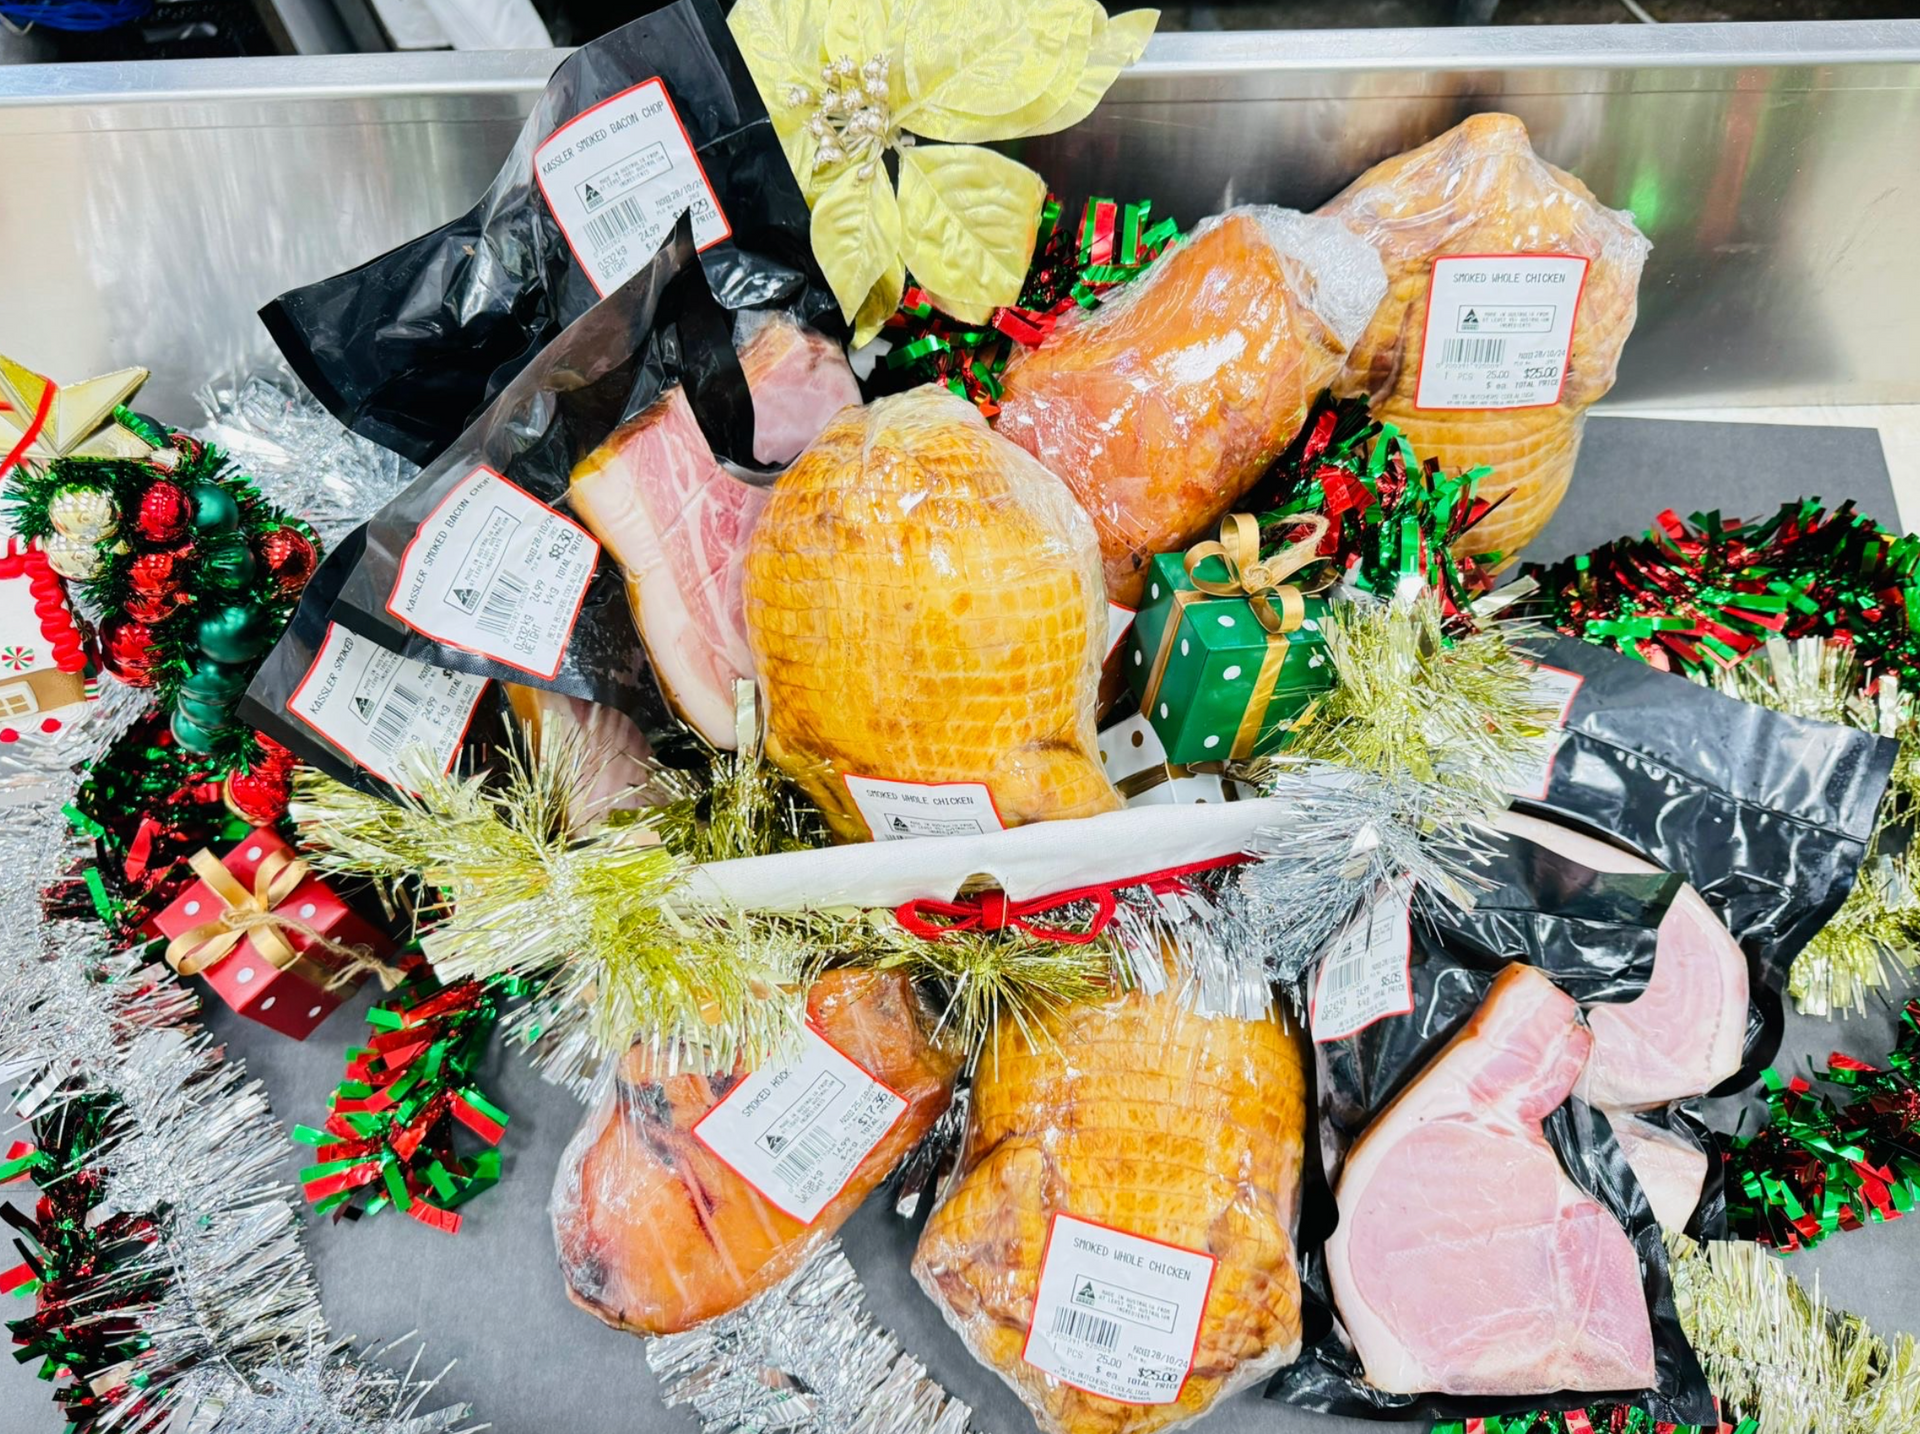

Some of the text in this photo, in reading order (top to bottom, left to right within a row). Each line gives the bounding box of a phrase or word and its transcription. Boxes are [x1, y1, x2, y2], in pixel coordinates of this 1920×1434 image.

[542, 100, 663, 174] KASSLER SMOKED BACON CHOP
[602, 257, 627, 279] WEIGHT
[695, 210, 716, 224] PRICE
[638, 223, 659, 241] 24.99
[1453, 272, 1565, 283] SMOKED WHOLE CHICKEN
[1486, 370, 1509, 379] 25.00
[1524, 366, 1557, 378] $25.00
[1486, 381, 1492, 389] $
[1538, 378, 1558, 386] PRICE
[406, 477, 489, 612] KASSLER SMOKED BACON CHOP
[529, 579, 545, 602] 24.99
[548, 528, 573, 560] $8.30
[523, 623, 541, 655] WEIGHT
[542, 586, 559, 605] $/kg
[555, 558, 571, 579] TOTAL
[568, 531, 585, 555] PRICE
[309, 637, 353, 714] KASSLER SMOKED
[421, 696, 437, 720] 24.99
[432, 704, 450, 725] $/kg
[447, 678, 462, 697] TOTAL
[866, 789, 973, 805] SMOKED WHOLE CHICKEN
[742, 1088, 770, 1117] SMOKED
[832, 1136, 850, 1156] 14.99
[857, 1092, 888, 1125] $17.36
[799, 1179, 825, 1203] WEIGHT
[860, 1118, 878, 1134] TOTAL
[1074, 1237, 1190, 1280] SMOKED WHOLE CHICKEN
[1066, 1346, 1083, 1359] PCS
[1096, 1353, 1122, 1368] 25.00
[1138, 1367, 1177, 1382] $25.00
[1095, 1365, 1101, 1374] $
[1105, 1371, 1117, 1380] ea
[1127, 1377, 1148, 1386] TOTAL
[1151, 1349, 1188, 1368] 28/10/24
